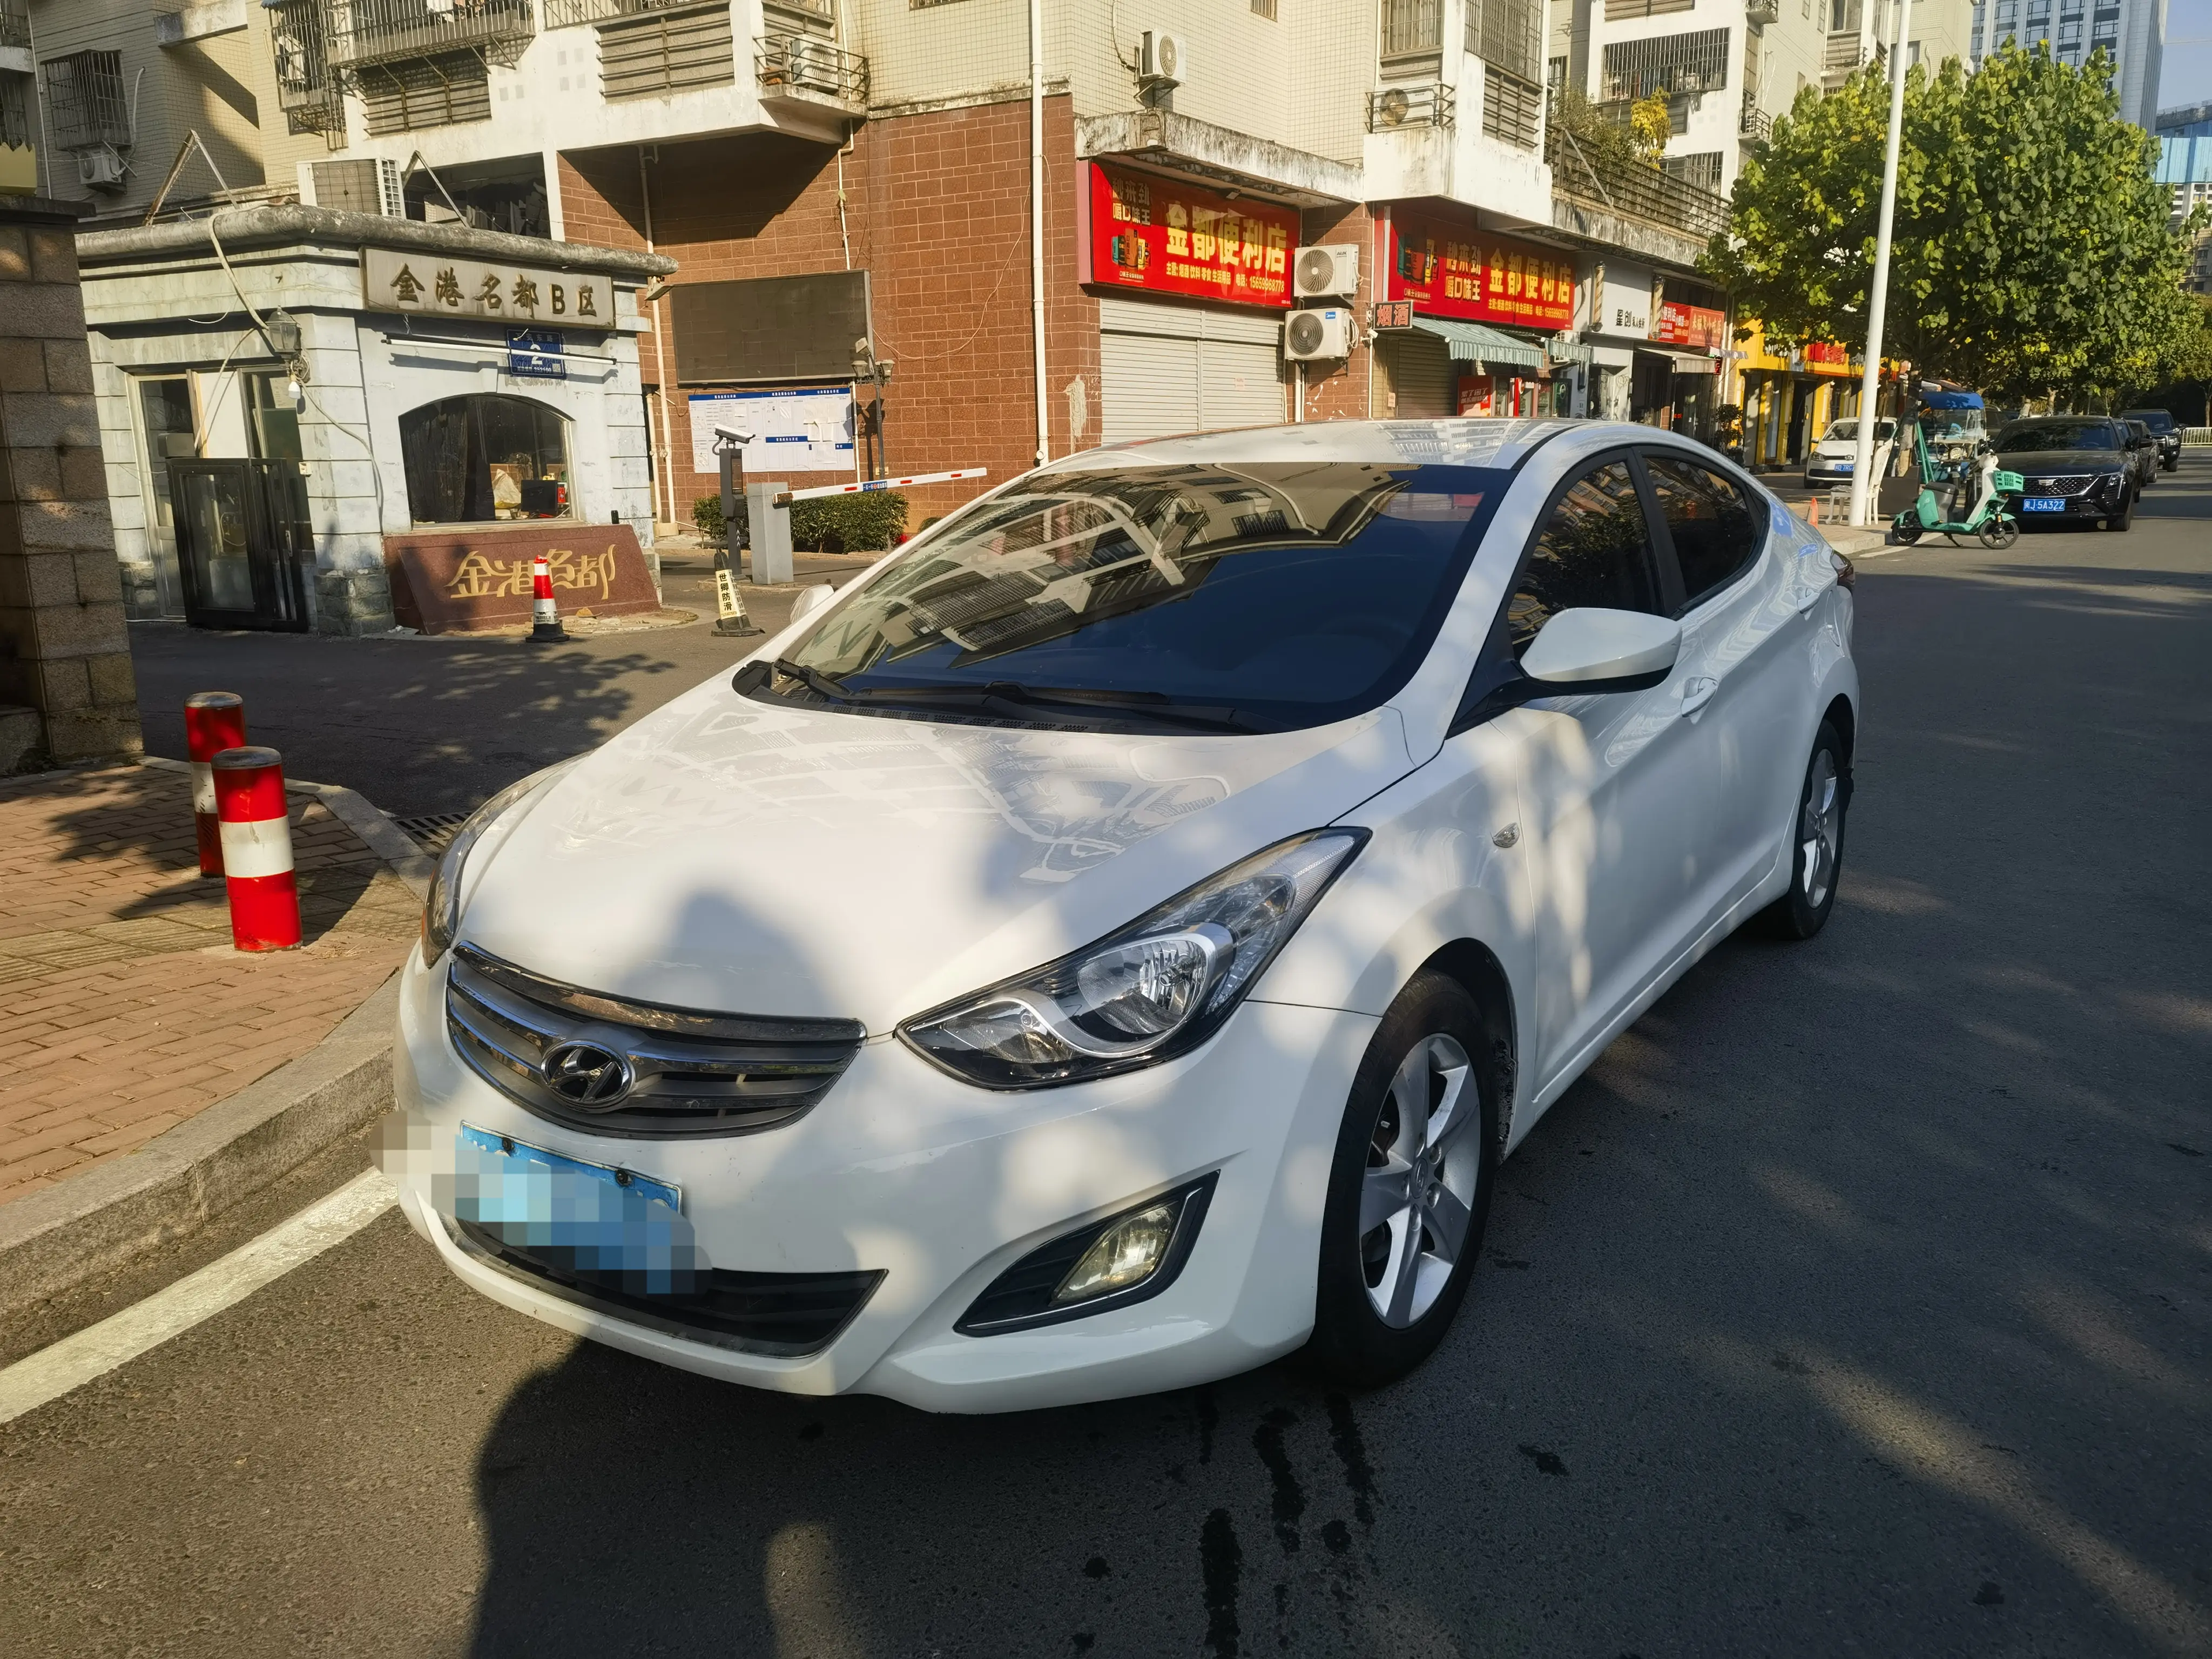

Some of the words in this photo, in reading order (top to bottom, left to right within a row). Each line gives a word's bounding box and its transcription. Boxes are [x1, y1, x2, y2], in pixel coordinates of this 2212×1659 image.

[1166, 200, 1286, 273] 金都便利店
[1446, 241, 1481, 275] 秒来劲
[390, 262, 597, 319] 金港名都B区
[1445, 275, 1481, 301] 嚼口味王
[1489, 248, 1572, 304] 金都便利店
[1377, 304, 1409, 327] 烟酒
[530, 344, 543, 365] 2
